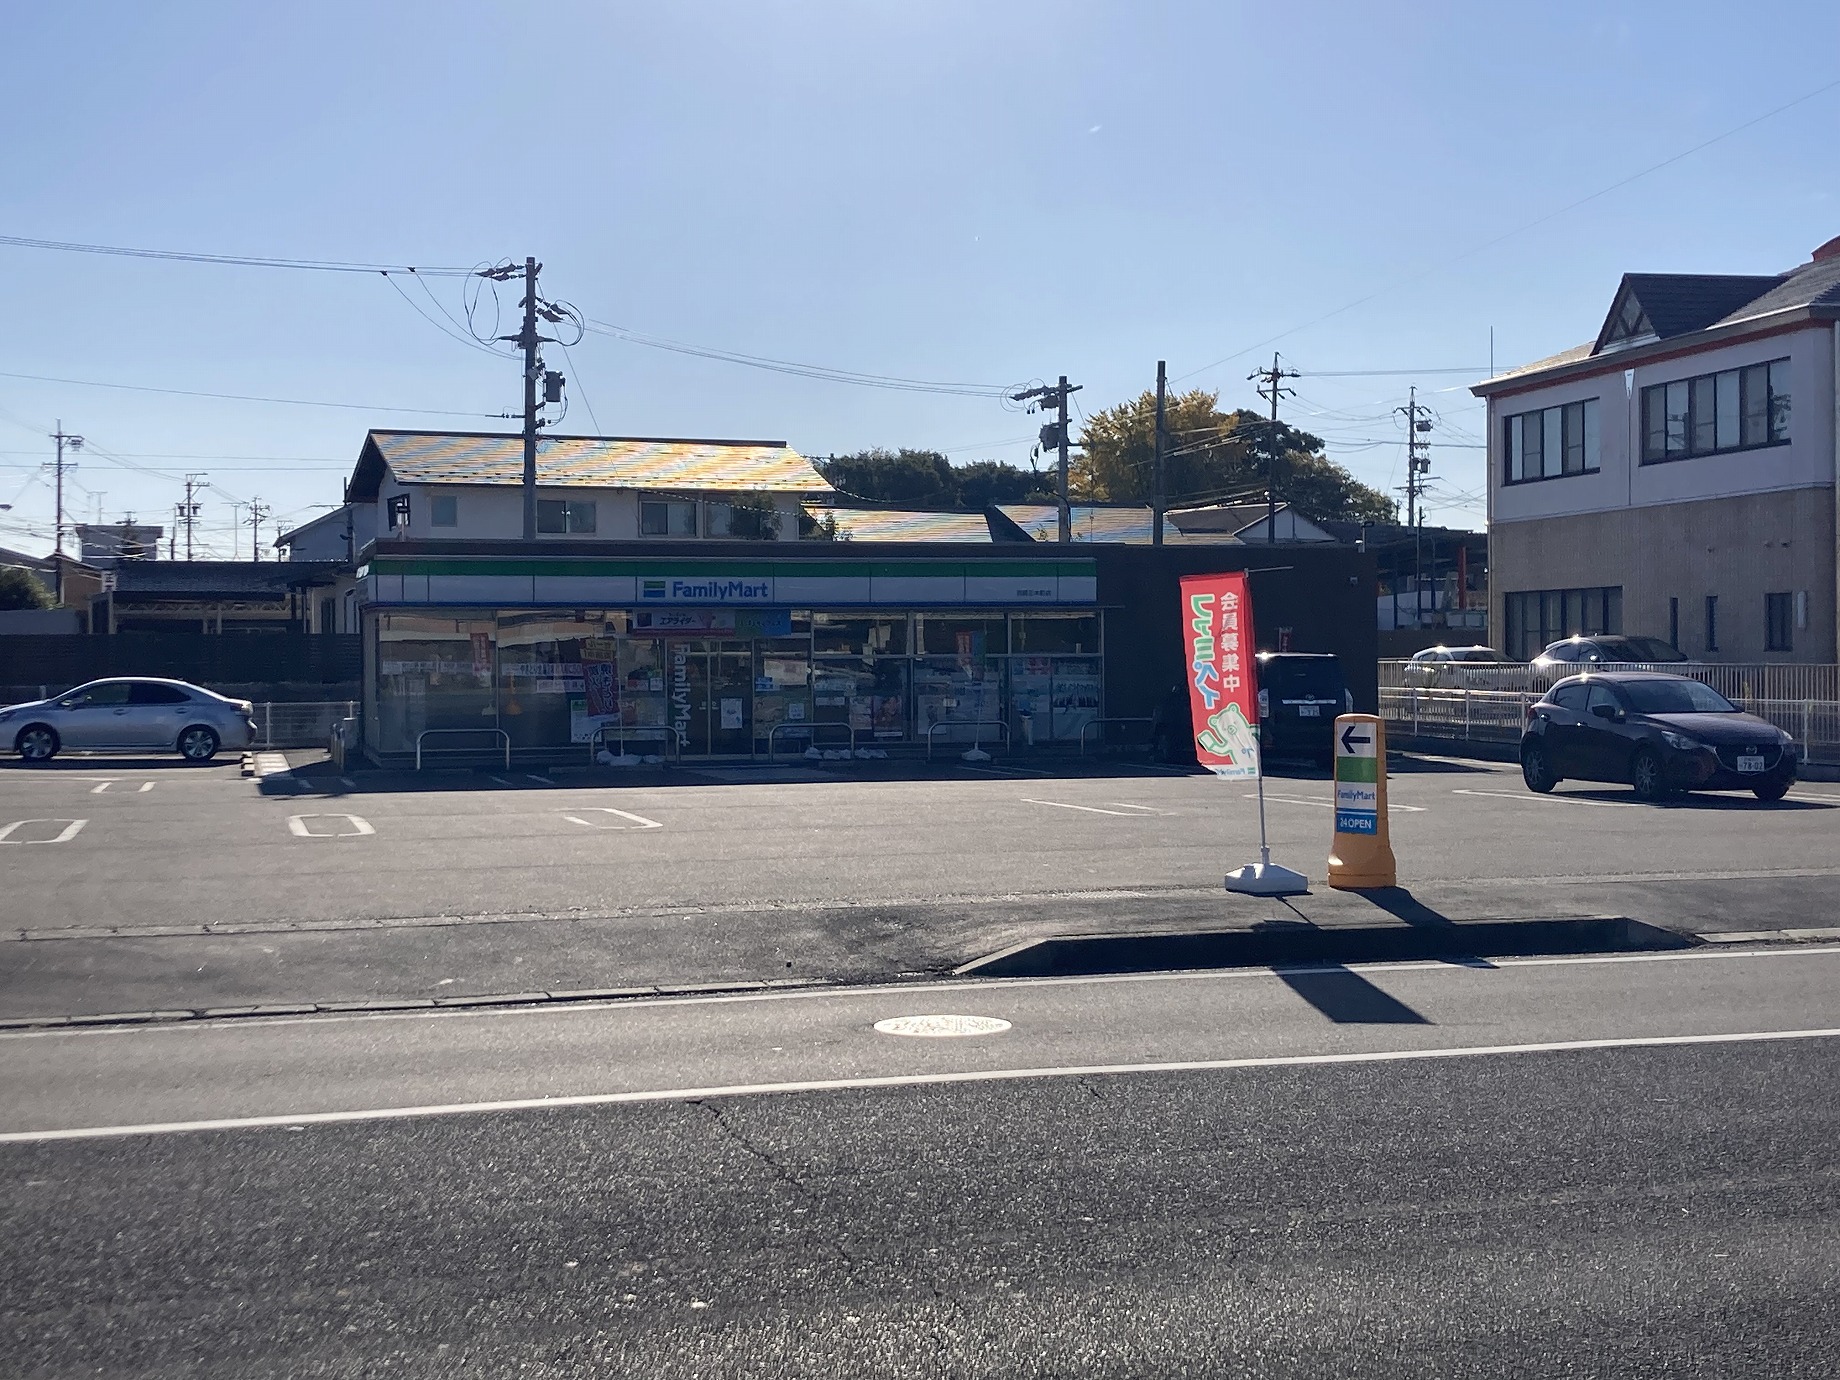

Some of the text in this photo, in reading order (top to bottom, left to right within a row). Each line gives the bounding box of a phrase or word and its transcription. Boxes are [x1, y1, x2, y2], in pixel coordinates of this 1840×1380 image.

[672, 581, 769, 600] FamilyMart
[671, 643, 692, 747] FamilyMart
[1338, 790, 1376, 802] FamilyMart
